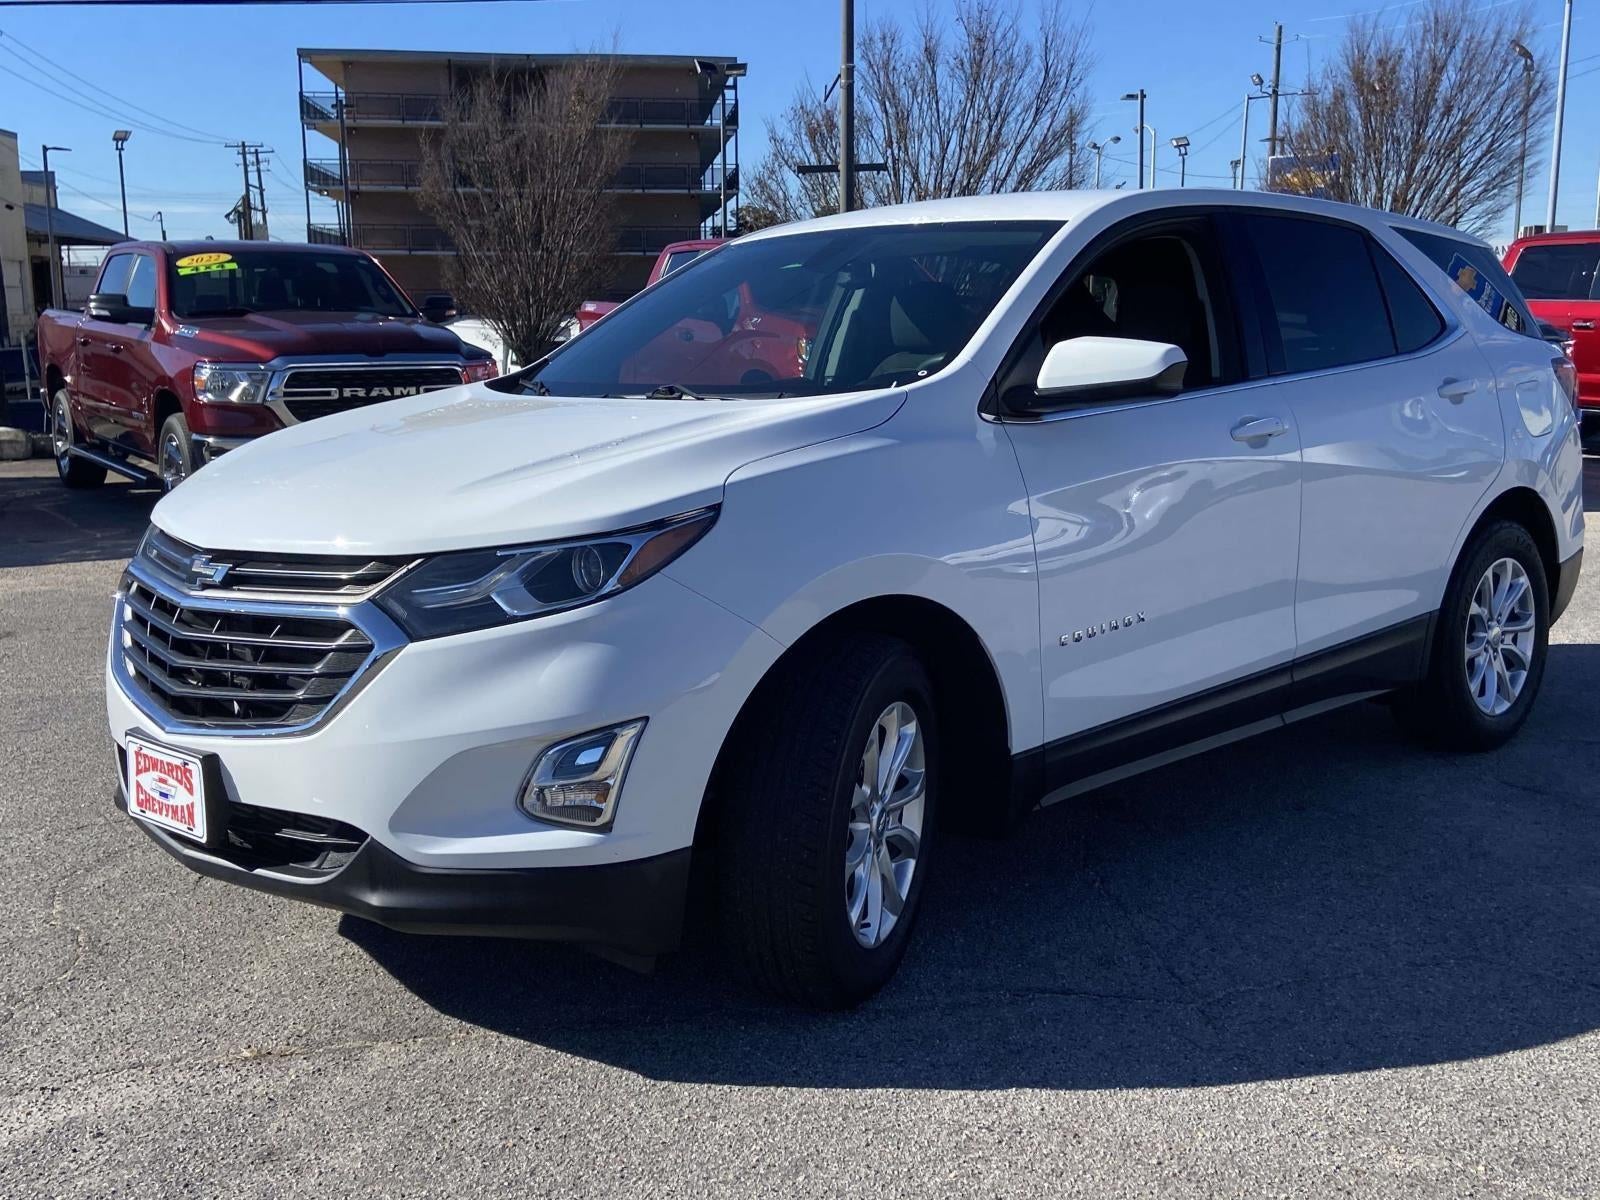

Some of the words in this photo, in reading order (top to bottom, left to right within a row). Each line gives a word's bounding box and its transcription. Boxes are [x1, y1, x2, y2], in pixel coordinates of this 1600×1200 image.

[187, 255, 221, 265] 2022
[343, 386, 417, 397] RAM
[1059, 611, 1145, 646] EQUINOX
[135, 750, 194, 797] EDWARDS
[135, 779, 195, 828] CHEVYMAN
